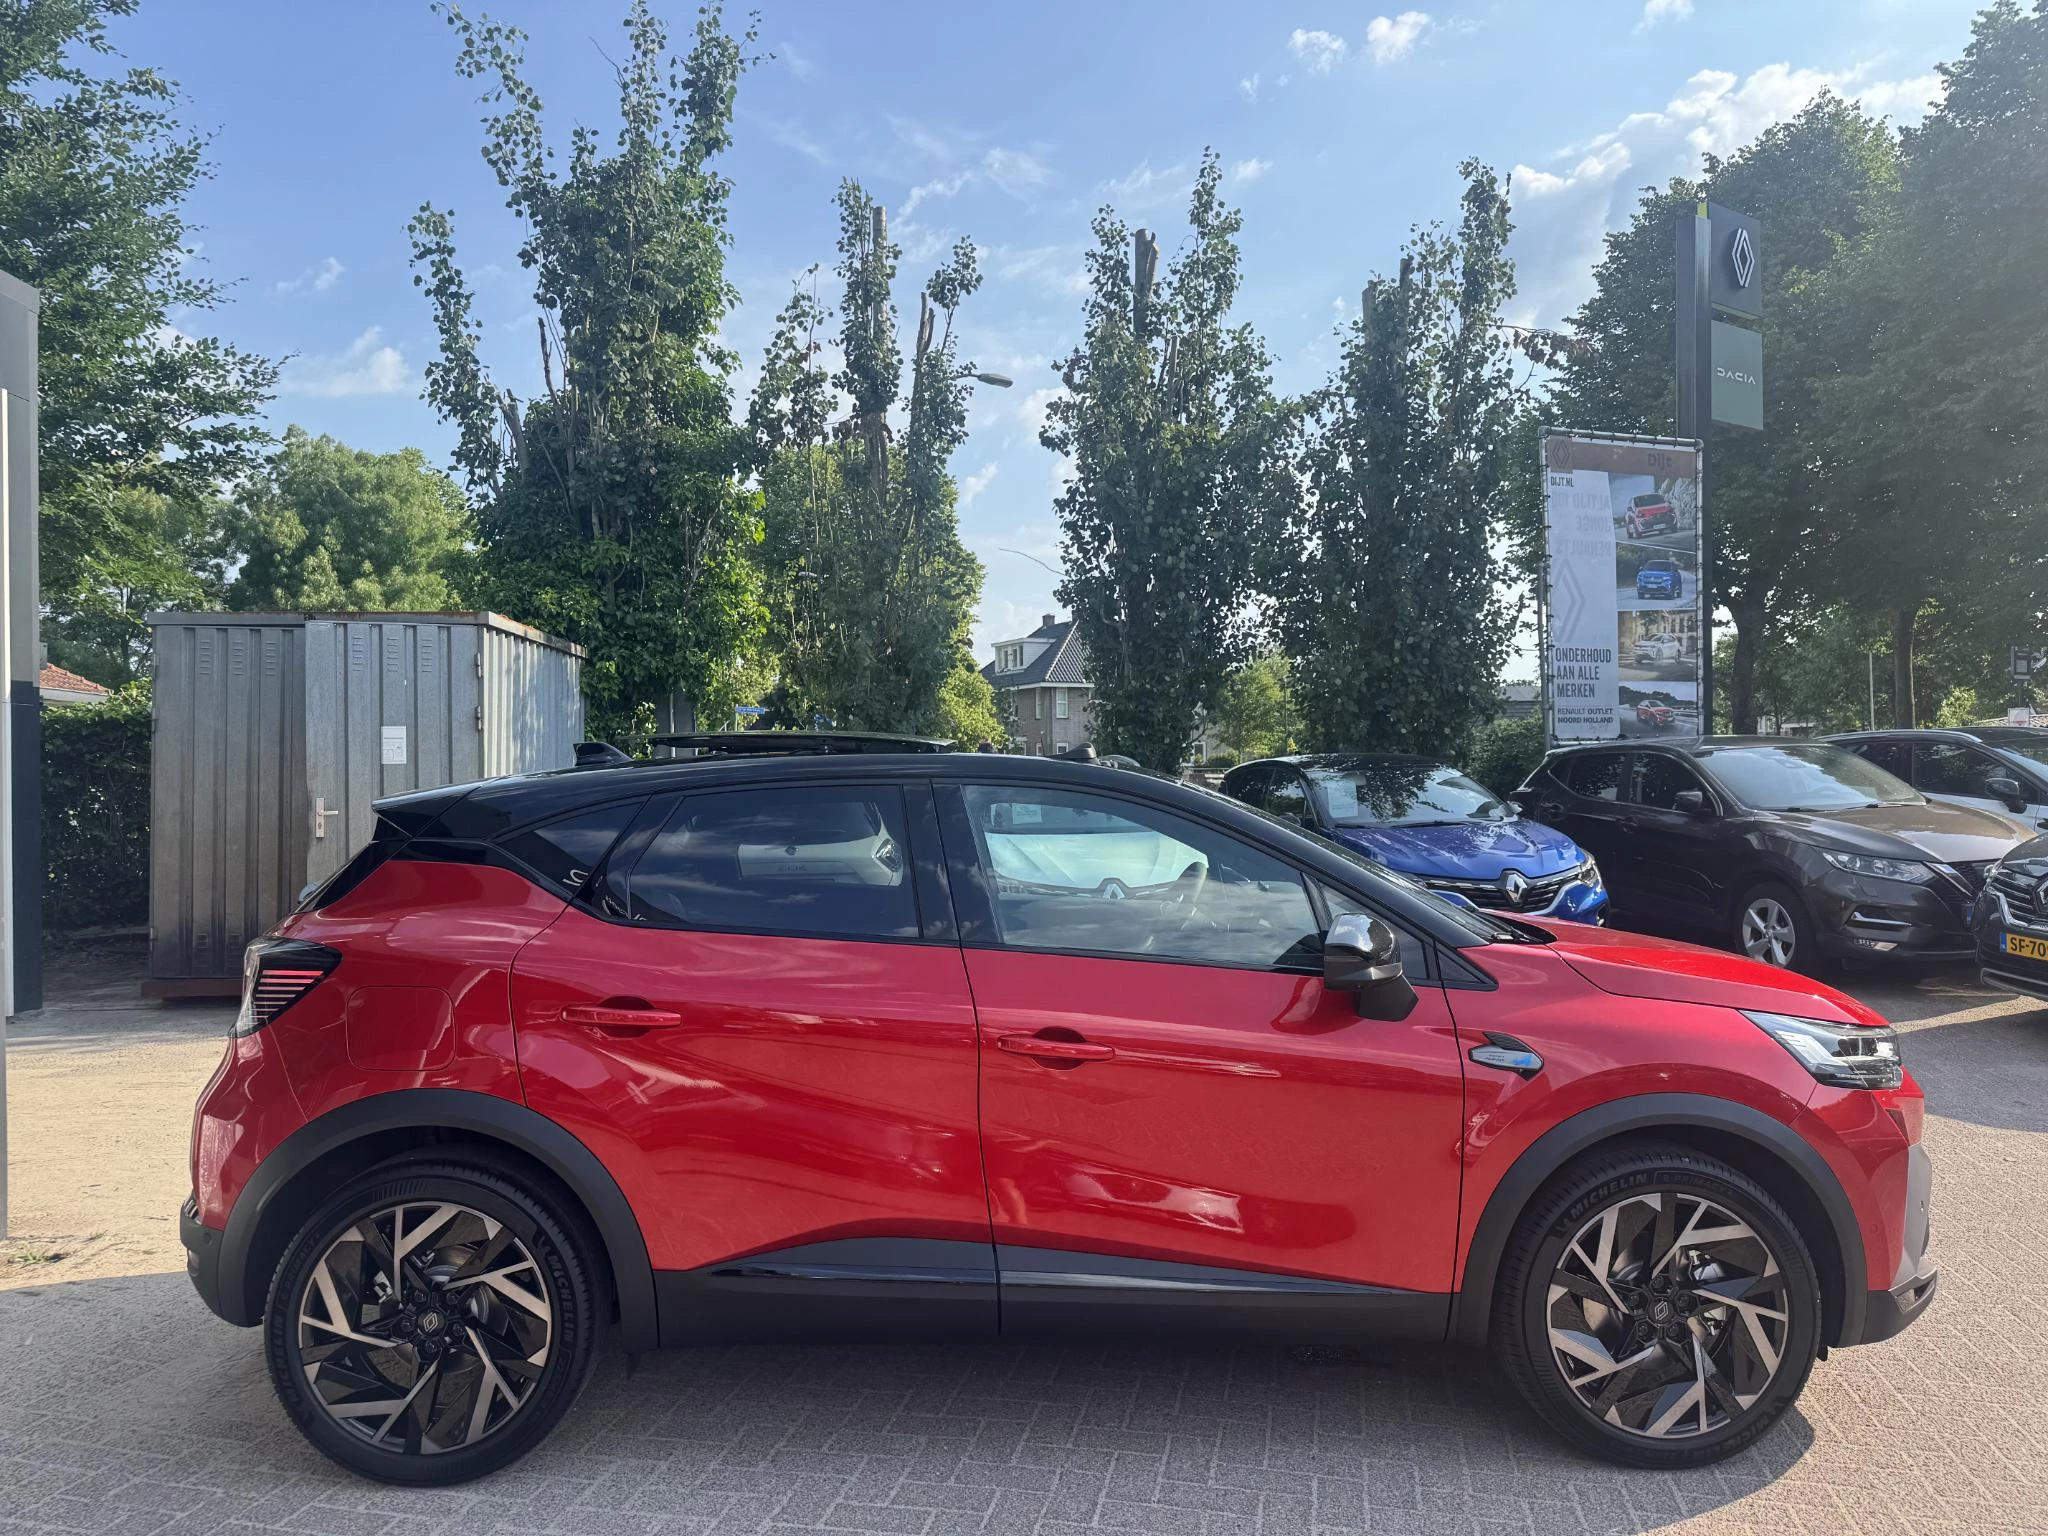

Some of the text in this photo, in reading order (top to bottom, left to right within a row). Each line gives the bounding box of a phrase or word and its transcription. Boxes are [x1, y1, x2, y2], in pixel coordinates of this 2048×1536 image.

[1717, 367, 1756, 385] DACIA
[1555, 647, 1612, 663] ONDERHOUD
[1556, 665, 1600, 681] AAN ALLE
[1557, 683, 1595, 698] MERKEN
[1557, 707, 1585, 715] RENAULT
[2010, 936, 2048, 957] SF-70
[1570, 1172, 1649, 1221] MICHELIN
[548, 1254, 575, 1342] MICHELIN
